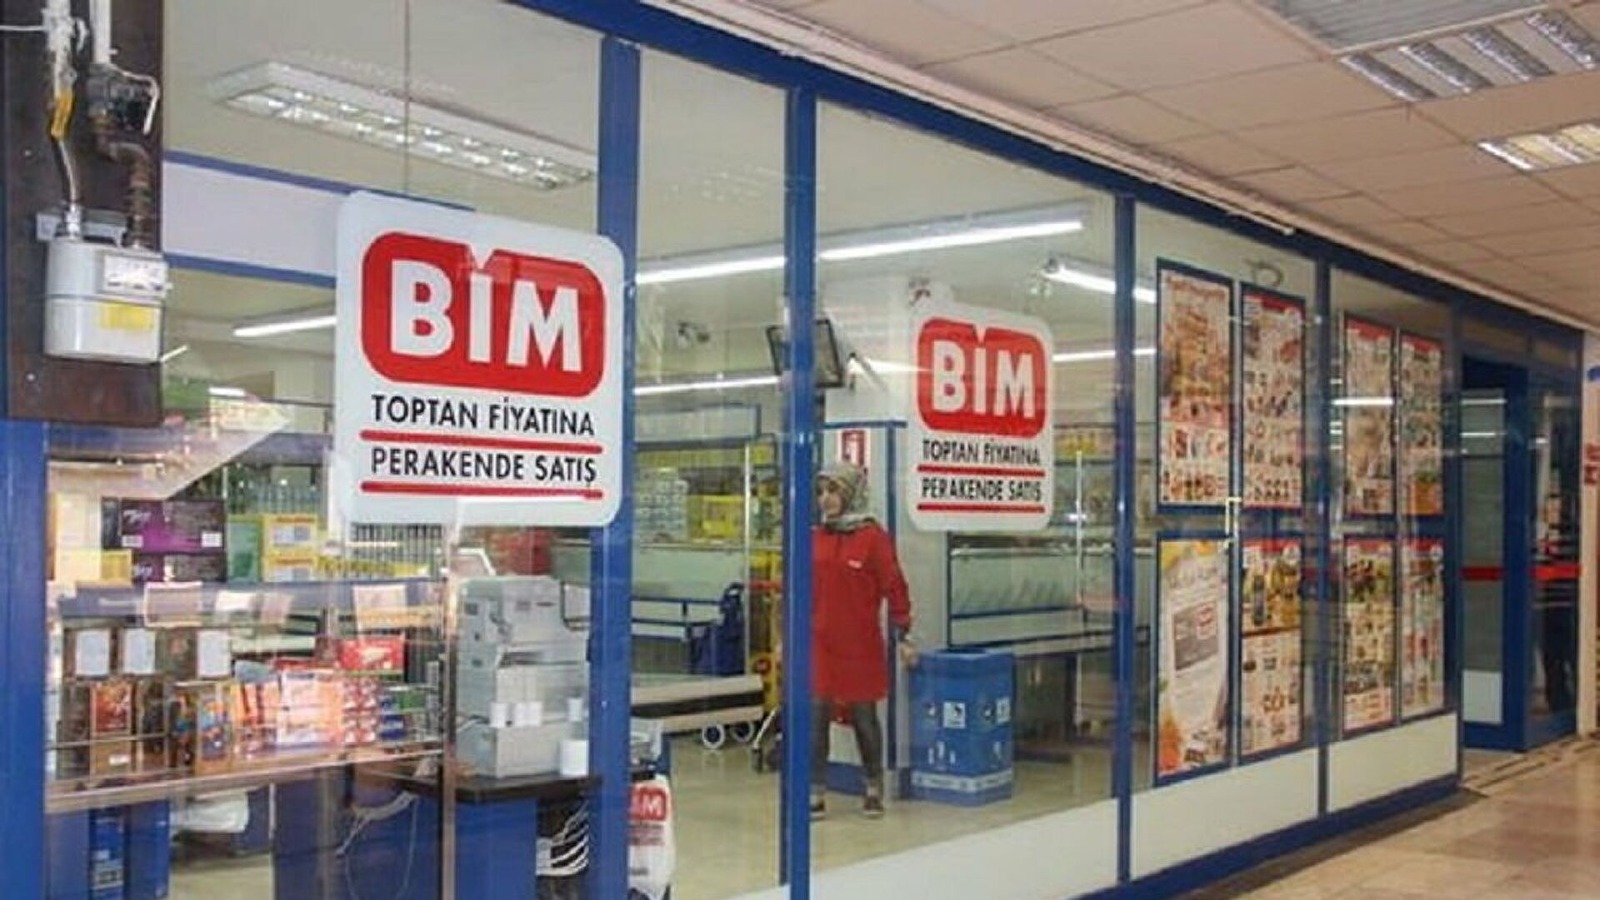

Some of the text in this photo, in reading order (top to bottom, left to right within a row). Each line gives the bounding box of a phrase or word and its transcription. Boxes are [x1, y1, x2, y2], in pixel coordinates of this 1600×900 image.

[371, 394, 595, 436] TOPTAN FİYATINA
[922, 439, 979, 463] TOPTAN
[371, 447, 597, 488] PERAKENDE SATIŞ
[921, 478, 1003, 501] PERAKENDE
